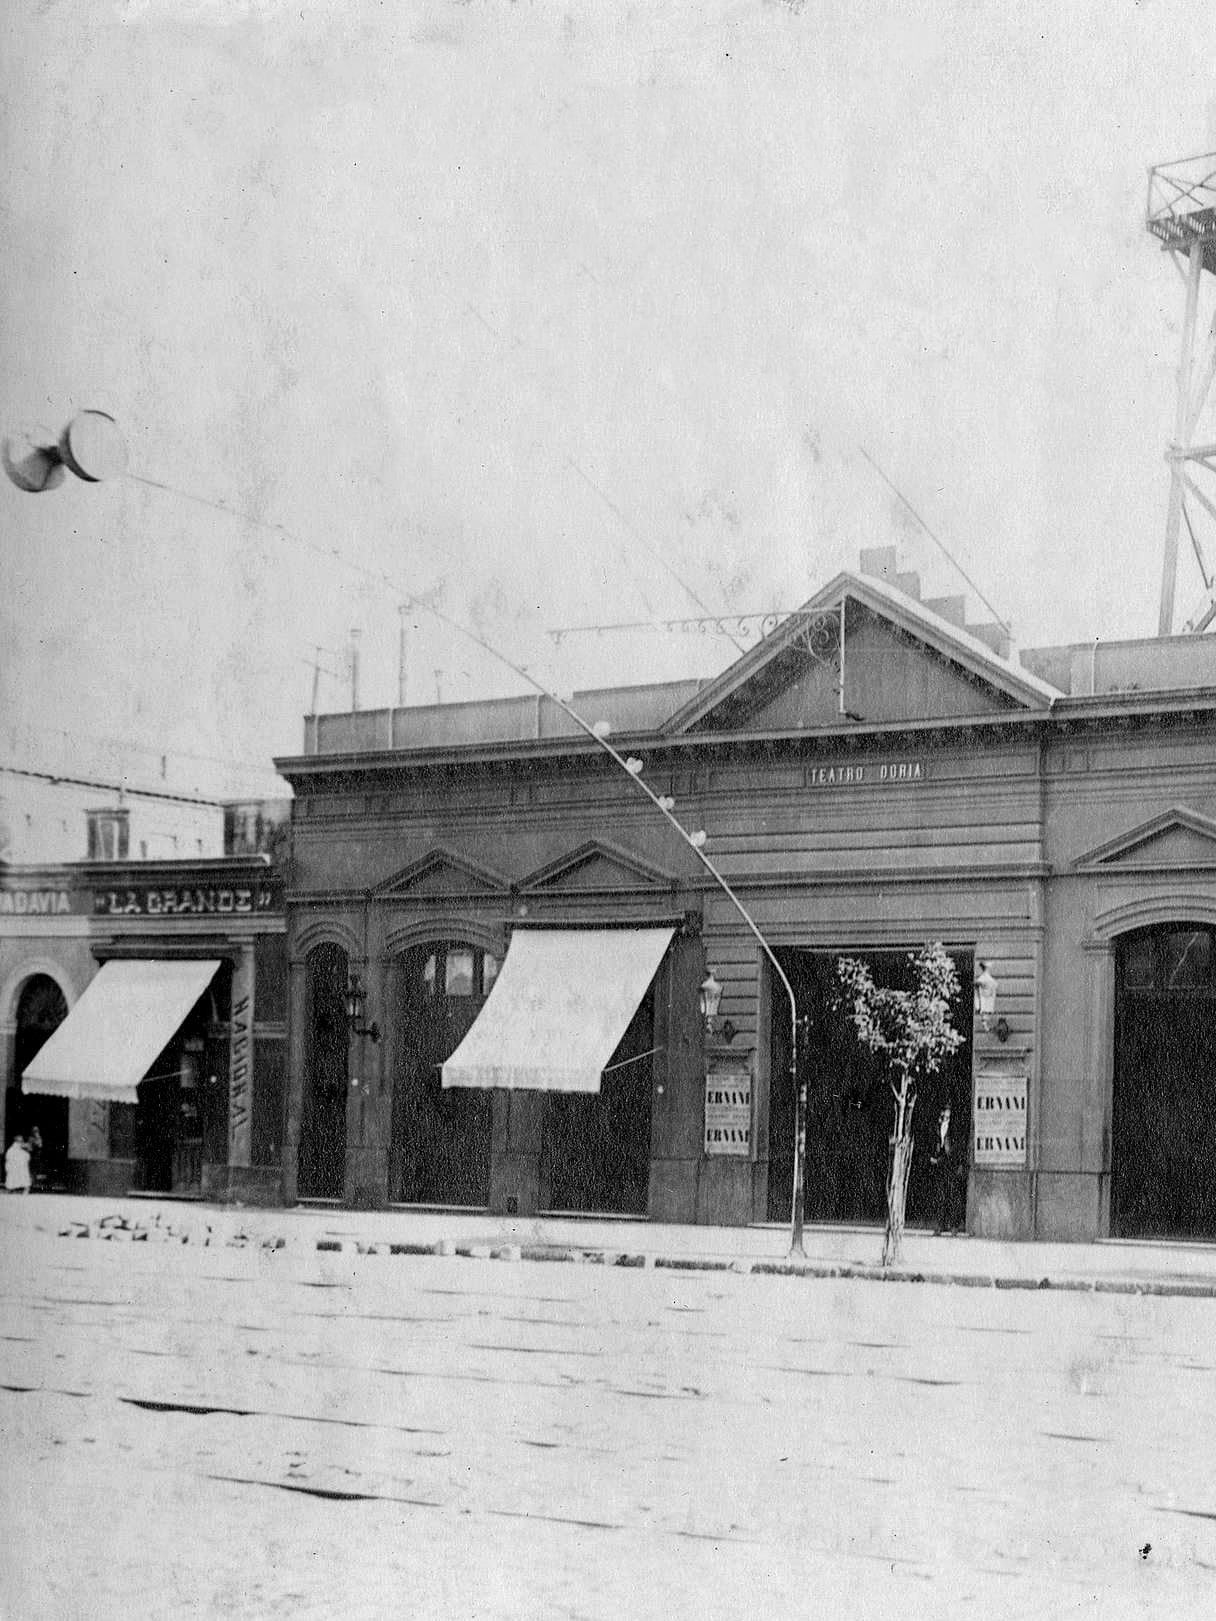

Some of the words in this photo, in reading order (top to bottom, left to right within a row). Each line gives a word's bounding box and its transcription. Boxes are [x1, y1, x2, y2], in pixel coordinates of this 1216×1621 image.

[811, 767, 864, 783] TEATRO
[880, 763, 920, 779] DORIA
[0, 891, 71, 913] ADAVIA
[707, 1091, 750, 1104] ERNANI
[977, 1096, 1025, 1110] ERNANI
[706, 1129, 749, 1142] ERNANI
[976, 1137, 1025, 1151] ERNANI
